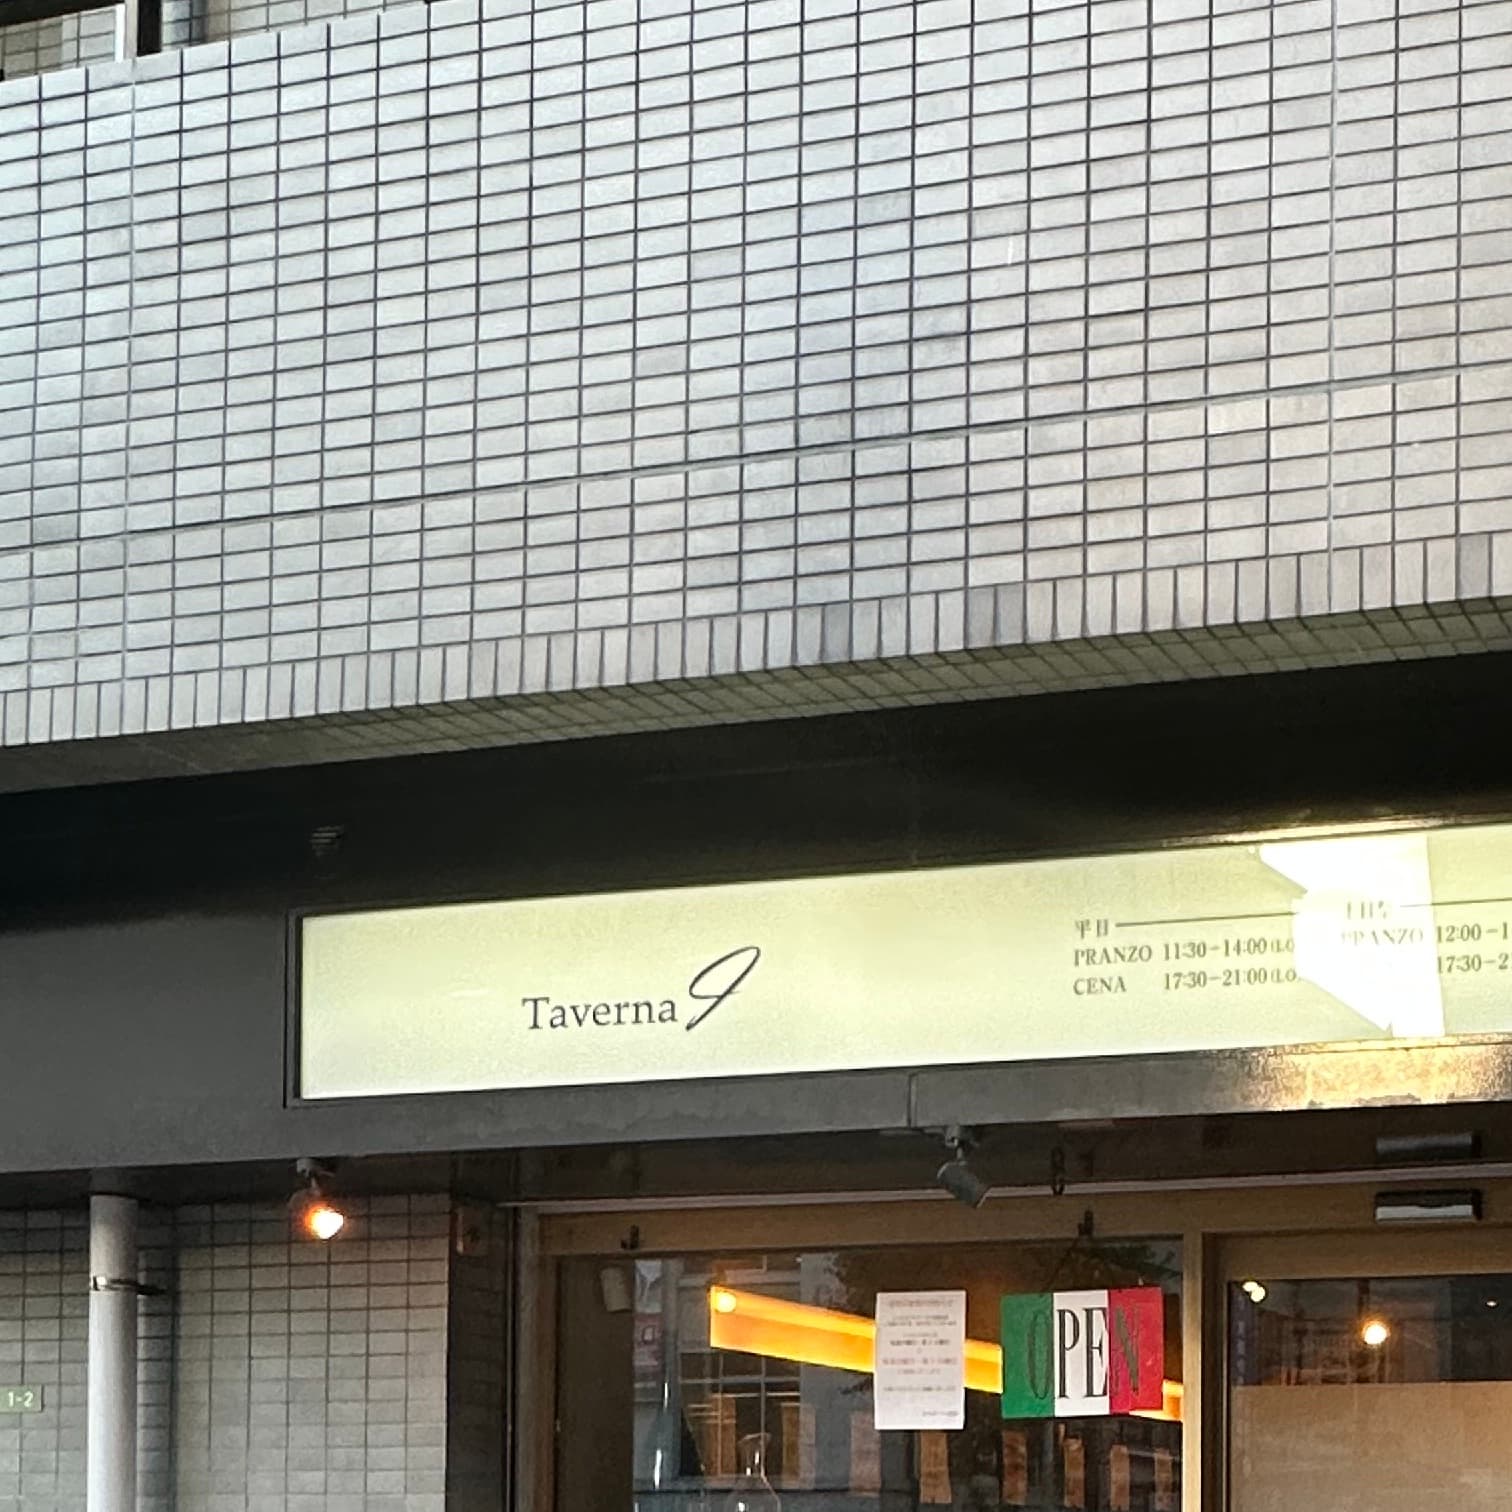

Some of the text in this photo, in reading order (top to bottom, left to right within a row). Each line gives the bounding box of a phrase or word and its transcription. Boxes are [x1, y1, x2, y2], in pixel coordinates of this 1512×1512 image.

[1072, 944, 1153, 967] PRANZO
[1073, 975, 1128, 996] CENA
[521, 996, 678, 1030] Taverna
[1027, 1304, 1140, 1401] OPEN
[7, 1390, 34, 1408] 1-2
